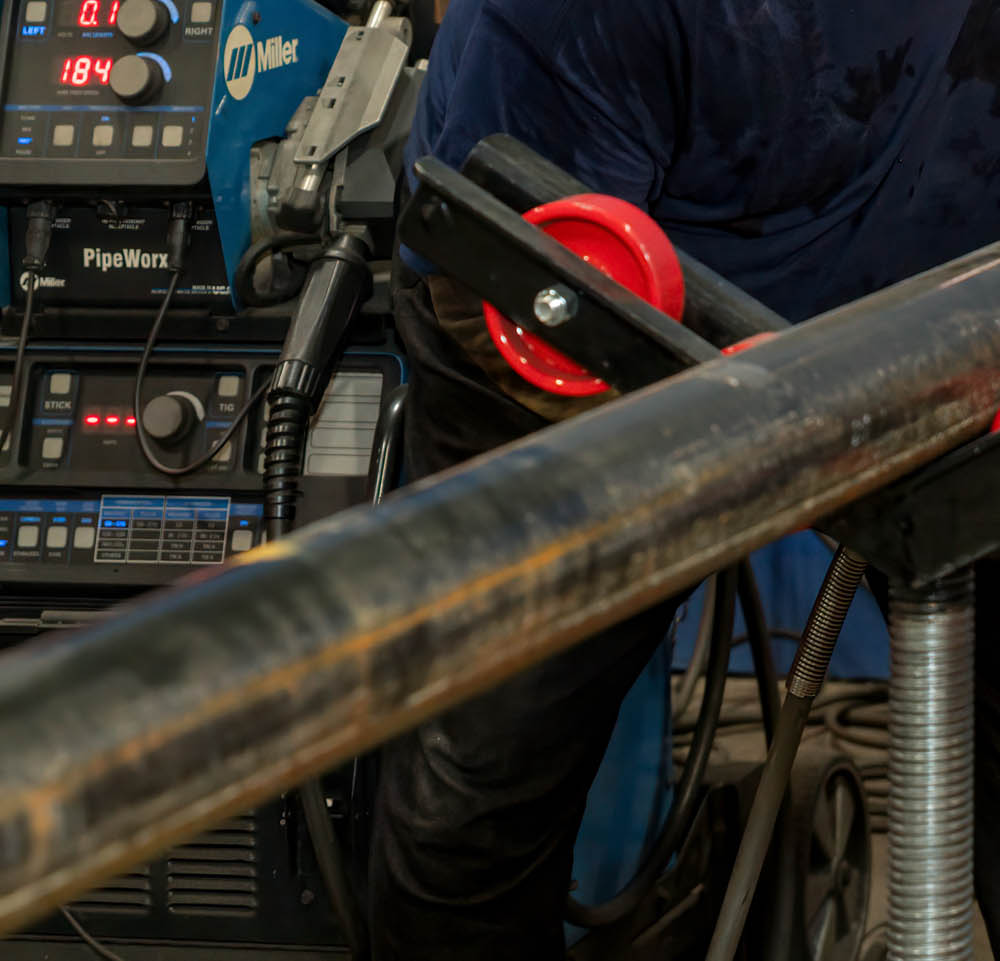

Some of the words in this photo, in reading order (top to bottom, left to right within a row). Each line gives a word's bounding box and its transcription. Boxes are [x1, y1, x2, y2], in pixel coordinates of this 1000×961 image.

[21, 26, 47, 36] LEFT
[184, 27, 214, 36] RIGHT
[257, 35, 299, 73] Miller
[61, 56, 113, 85] 184
[83, 248, 169, 272] PipeWorx
[39, 277, 66, 288] Miller
[44, 400, 72, 410] STICK
[218, 403, 235, 412] TIG
